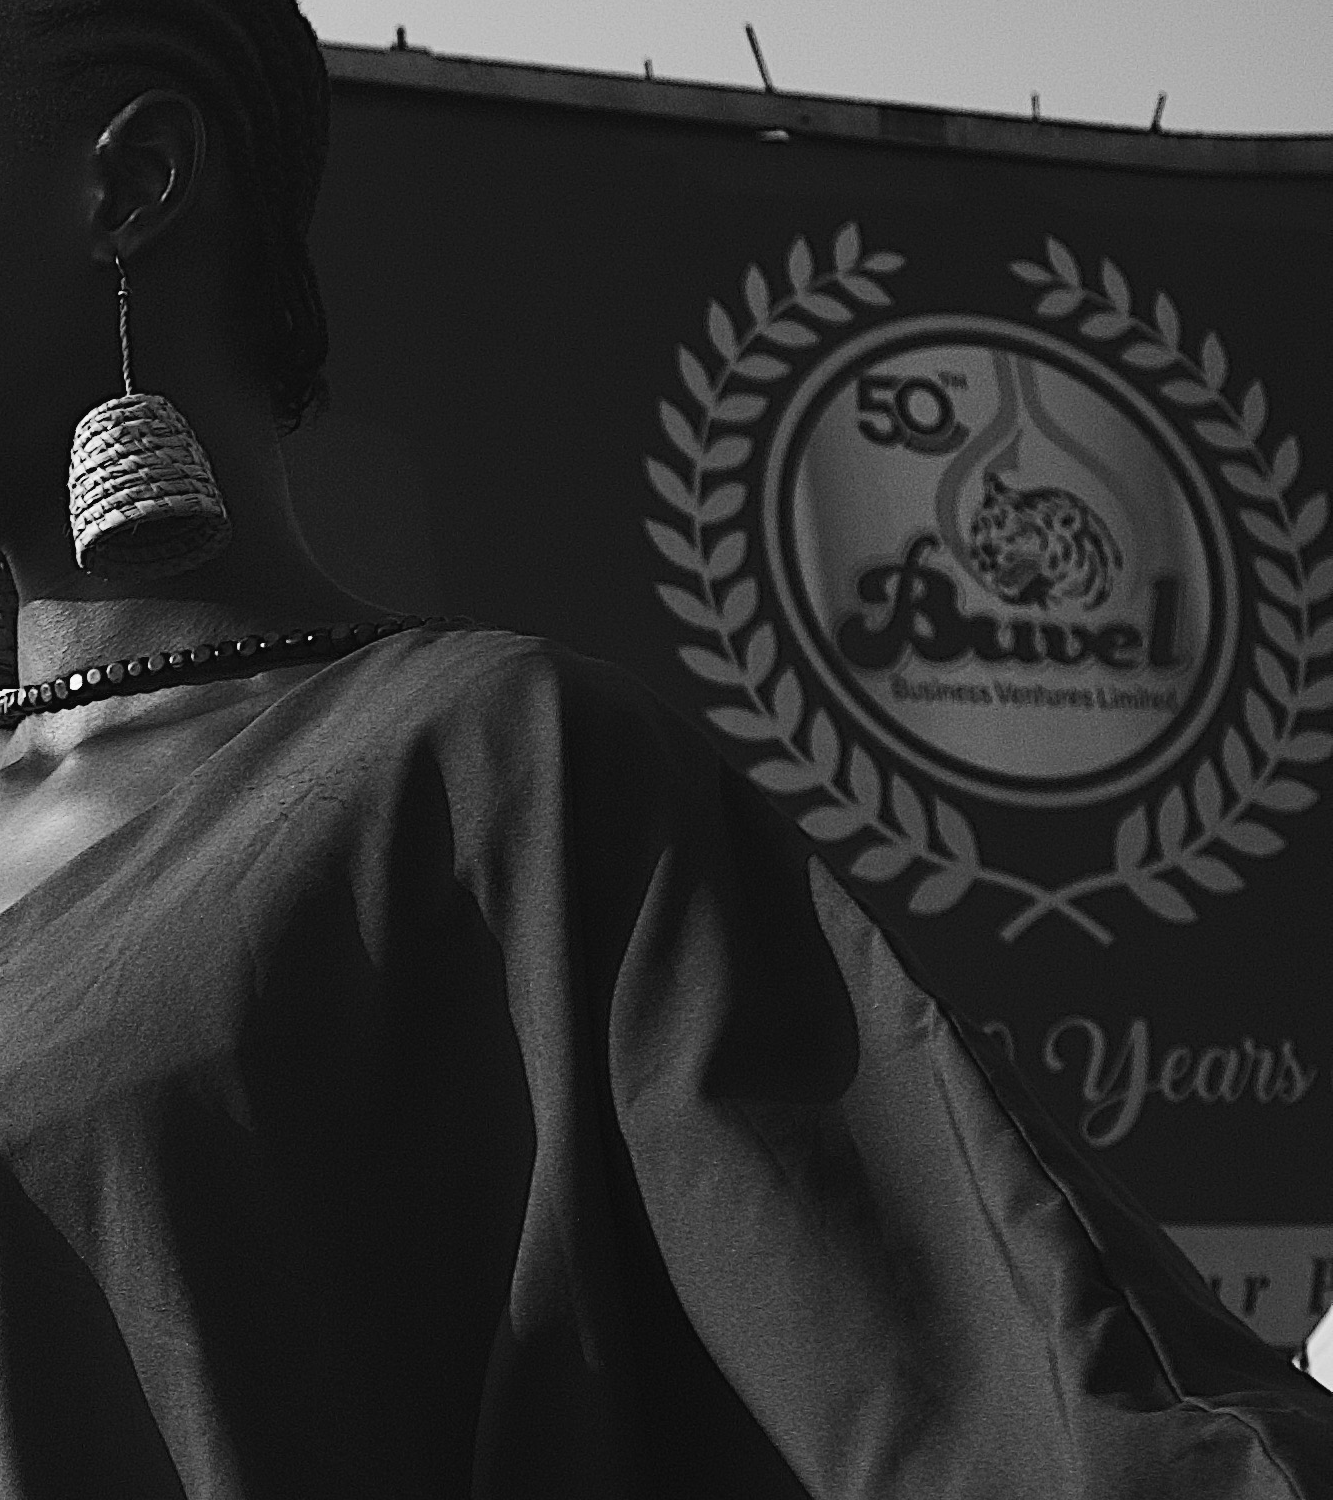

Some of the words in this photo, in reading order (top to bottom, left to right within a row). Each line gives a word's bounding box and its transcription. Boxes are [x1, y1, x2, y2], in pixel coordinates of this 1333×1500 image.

[891, 675, 993, 703] Business
[993, 682, 1093, 708] Ventures
[1098, 687, 1178, 712] Limited
[1045, 1018, 1318, 1147] Years
